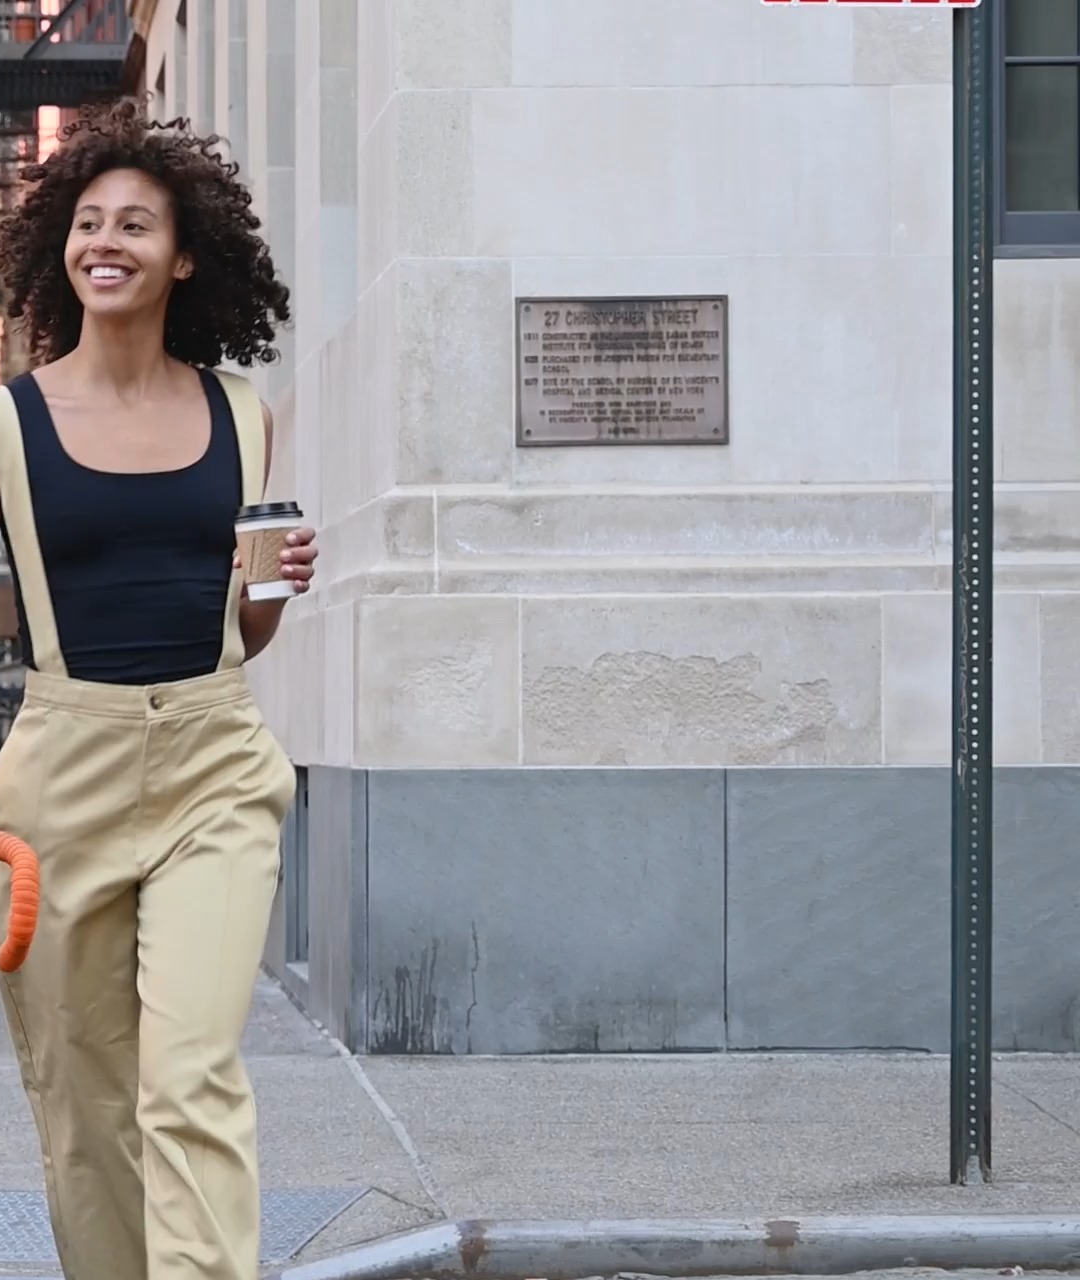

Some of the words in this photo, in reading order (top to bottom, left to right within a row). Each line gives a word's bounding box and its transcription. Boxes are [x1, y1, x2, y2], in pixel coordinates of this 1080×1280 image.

[544, 310, 560, 326] 27
[565, 310, 647, 326] CHRISTOPHER
[652, 309, 698, 325] STREET
